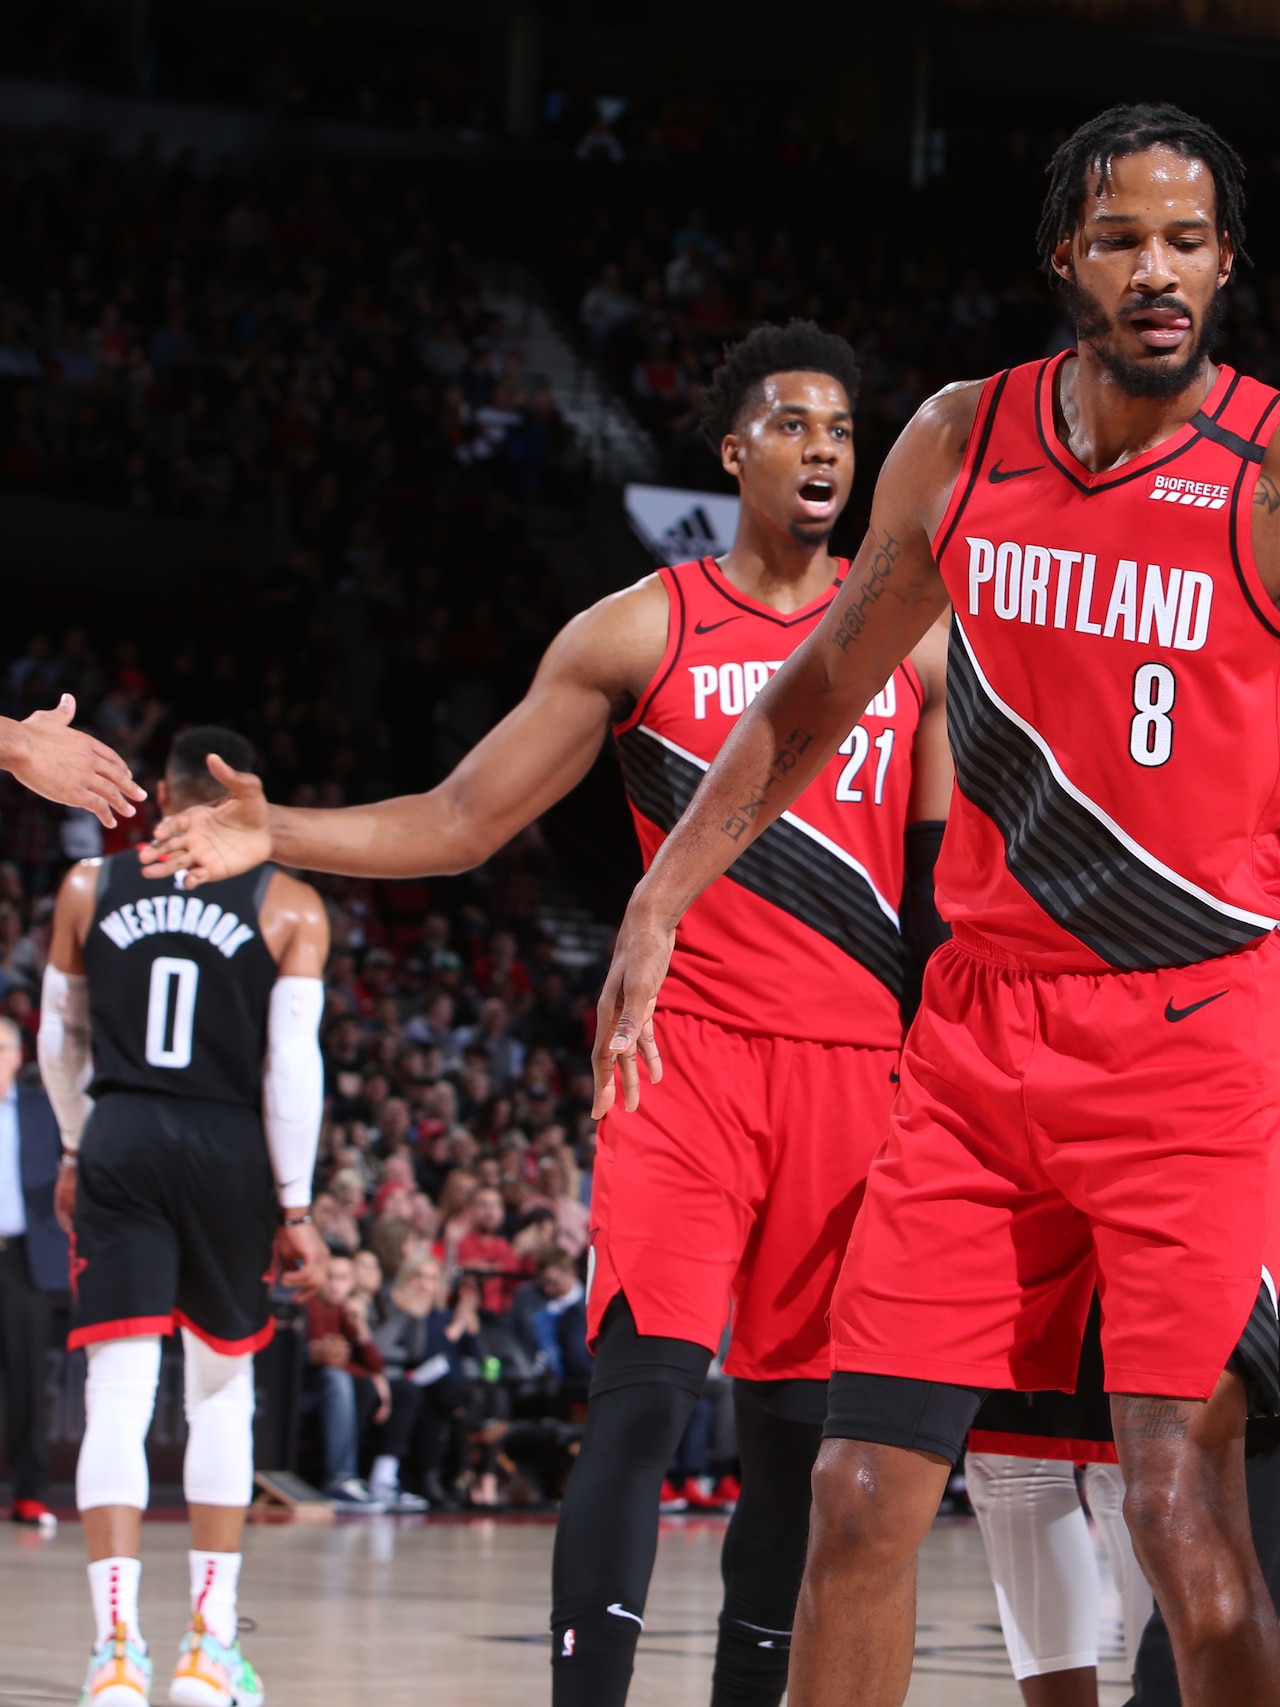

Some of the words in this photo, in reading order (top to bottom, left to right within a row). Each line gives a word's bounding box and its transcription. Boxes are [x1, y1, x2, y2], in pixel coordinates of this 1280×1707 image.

[965, 537, 1213, 651] PORTLAND
[835, 724, 895, 805] 21
[1130, 662, 1176, 767] 8
[99, 895, 254, 958] WESTBROOK
[145, 956, 199, 1069] 0
